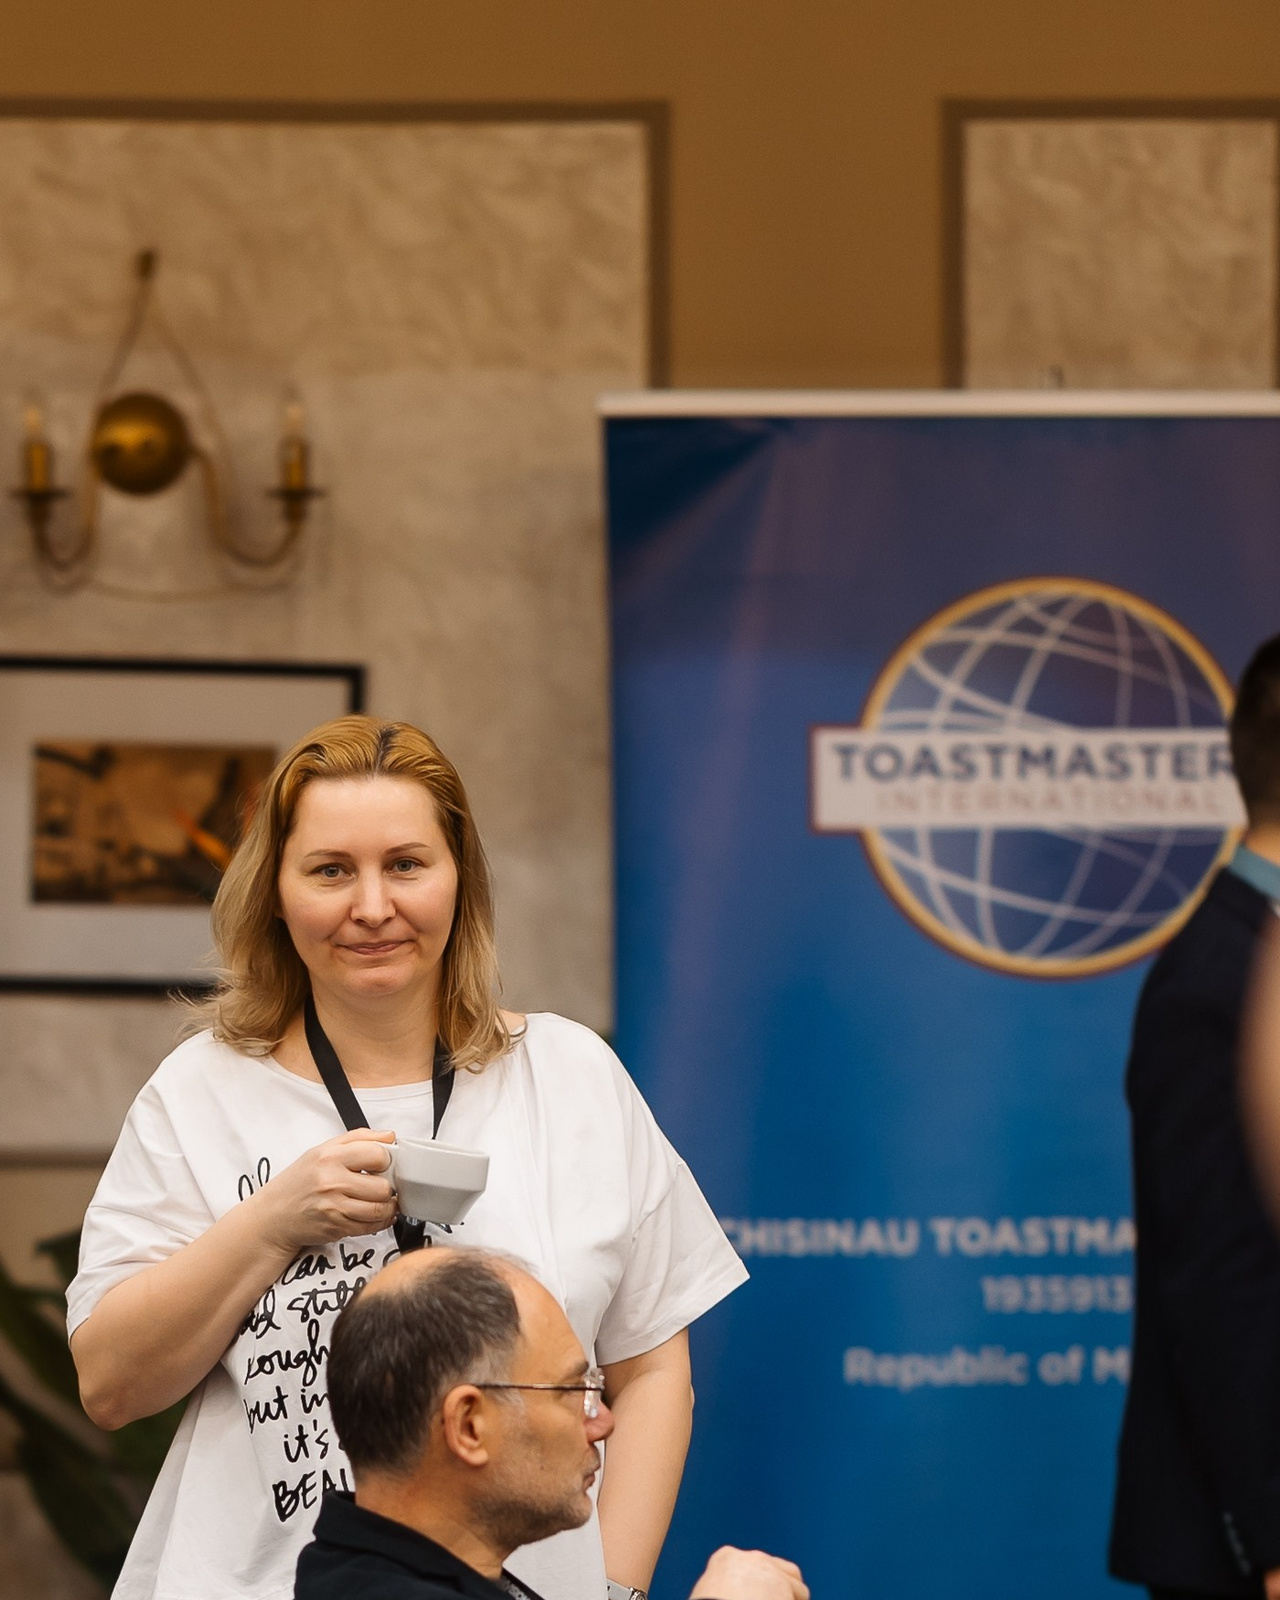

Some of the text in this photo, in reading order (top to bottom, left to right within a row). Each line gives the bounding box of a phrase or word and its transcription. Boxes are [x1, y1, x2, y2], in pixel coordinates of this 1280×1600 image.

[339, 1243, 375, 1272] be
[842, 1346, 1028, 1393] Republic
[1037, 1344, 1085, 1384] of
[284, 1419, 330, 1461] it's
